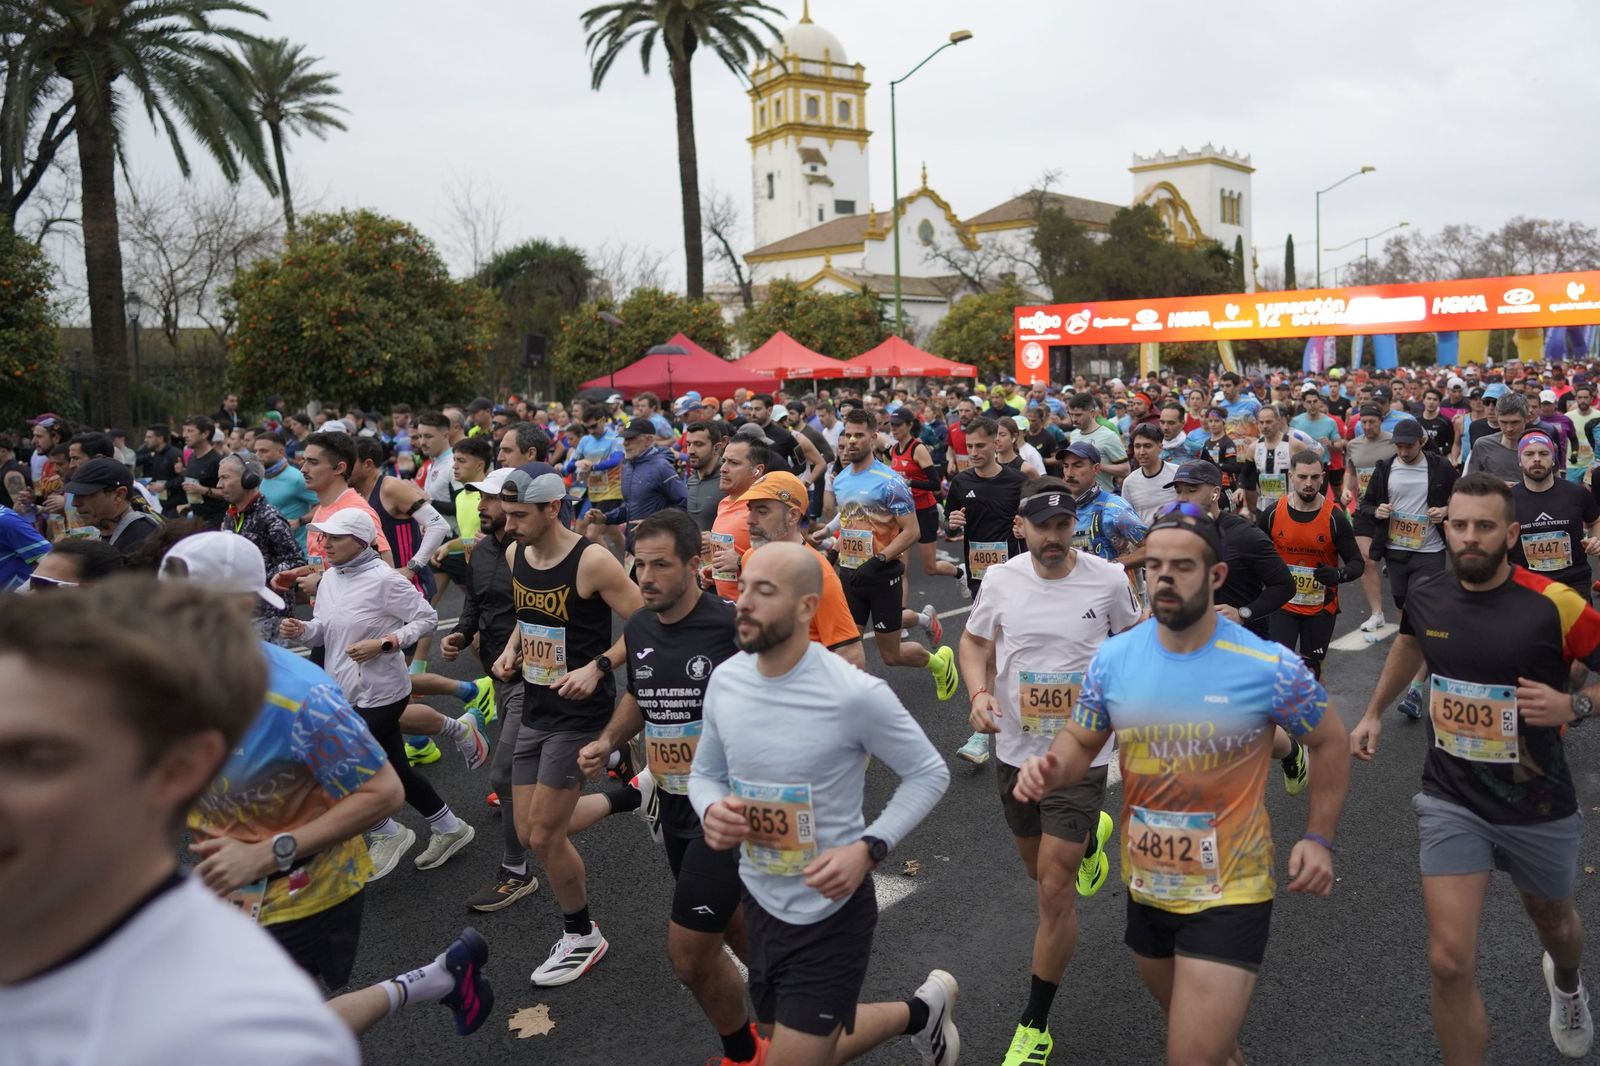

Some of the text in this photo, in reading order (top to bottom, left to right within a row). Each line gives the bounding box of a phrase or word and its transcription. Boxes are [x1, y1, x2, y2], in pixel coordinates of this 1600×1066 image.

[1432, 295, 1488, 314] HOKA
[1394, 520, 1419, 533] 7967
[843, 539, 863, 551] 6726
[1530, 542, 1559, 554] 7447
[974, 552, 998, 564] 4803
[638, 688, 701, 697] CLUB ATLETISMO
[1029, 687, 1072, 708] 5461
[659, 700, 702, 708] TORREVIEJ
[1442, 697, 1494, 728] 5203
[1132, 720, 1216, 743] MEDIO
[650, 743, 693, 764] 7650
[1137, 831, 1193, 863] 4812
